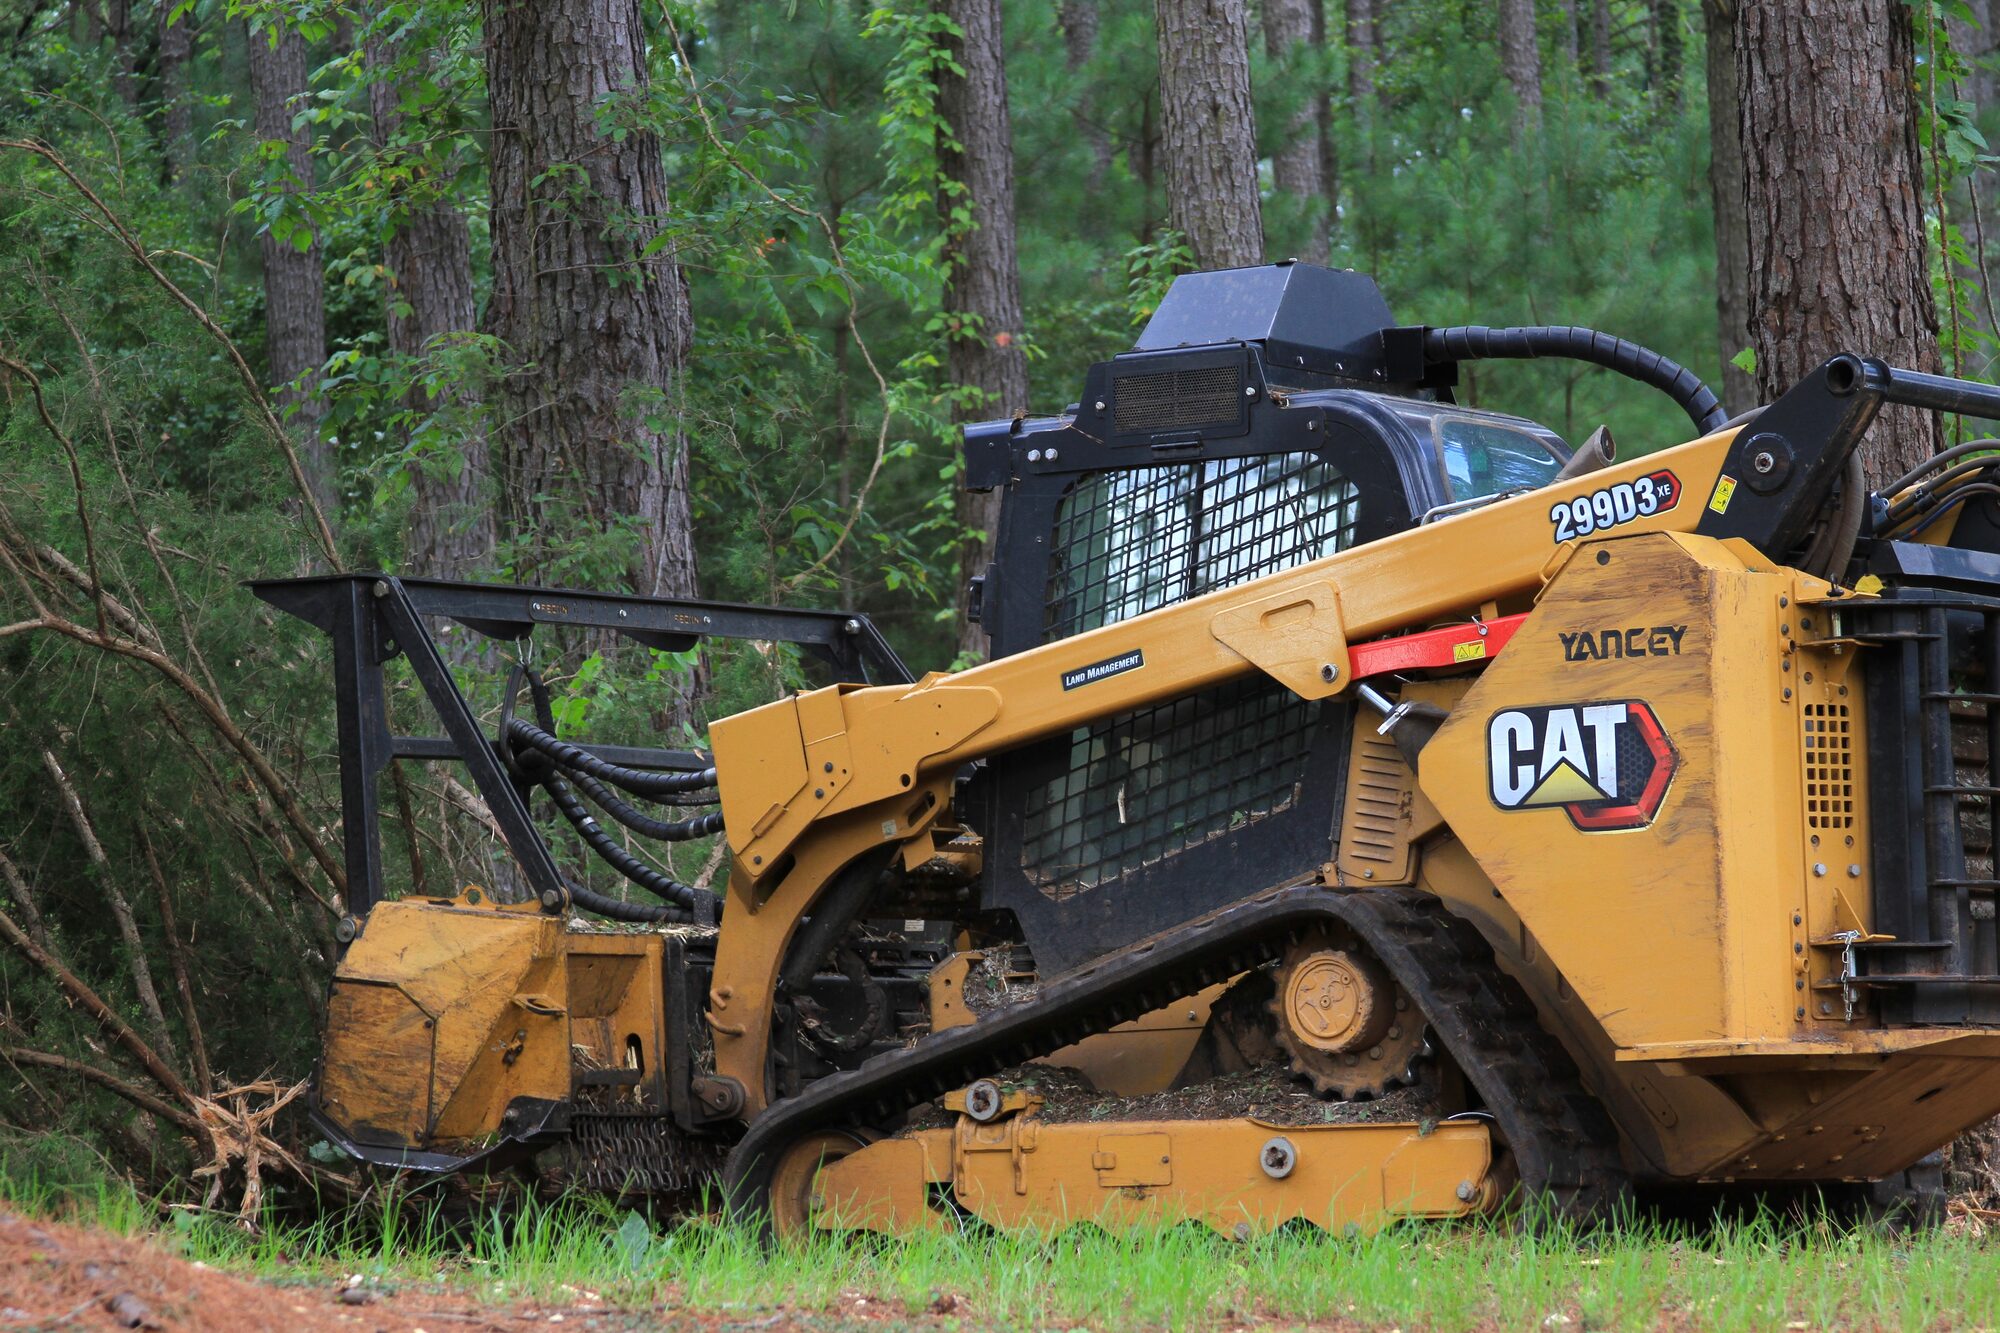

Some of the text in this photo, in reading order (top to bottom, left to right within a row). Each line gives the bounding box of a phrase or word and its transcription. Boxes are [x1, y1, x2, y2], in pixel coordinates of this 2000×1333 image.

[1551, 477, 1671, 541] 299D3 XE
[1558, 625, 1688, 661] YANCEY
[1490, 703, 1627, 806] CAT
